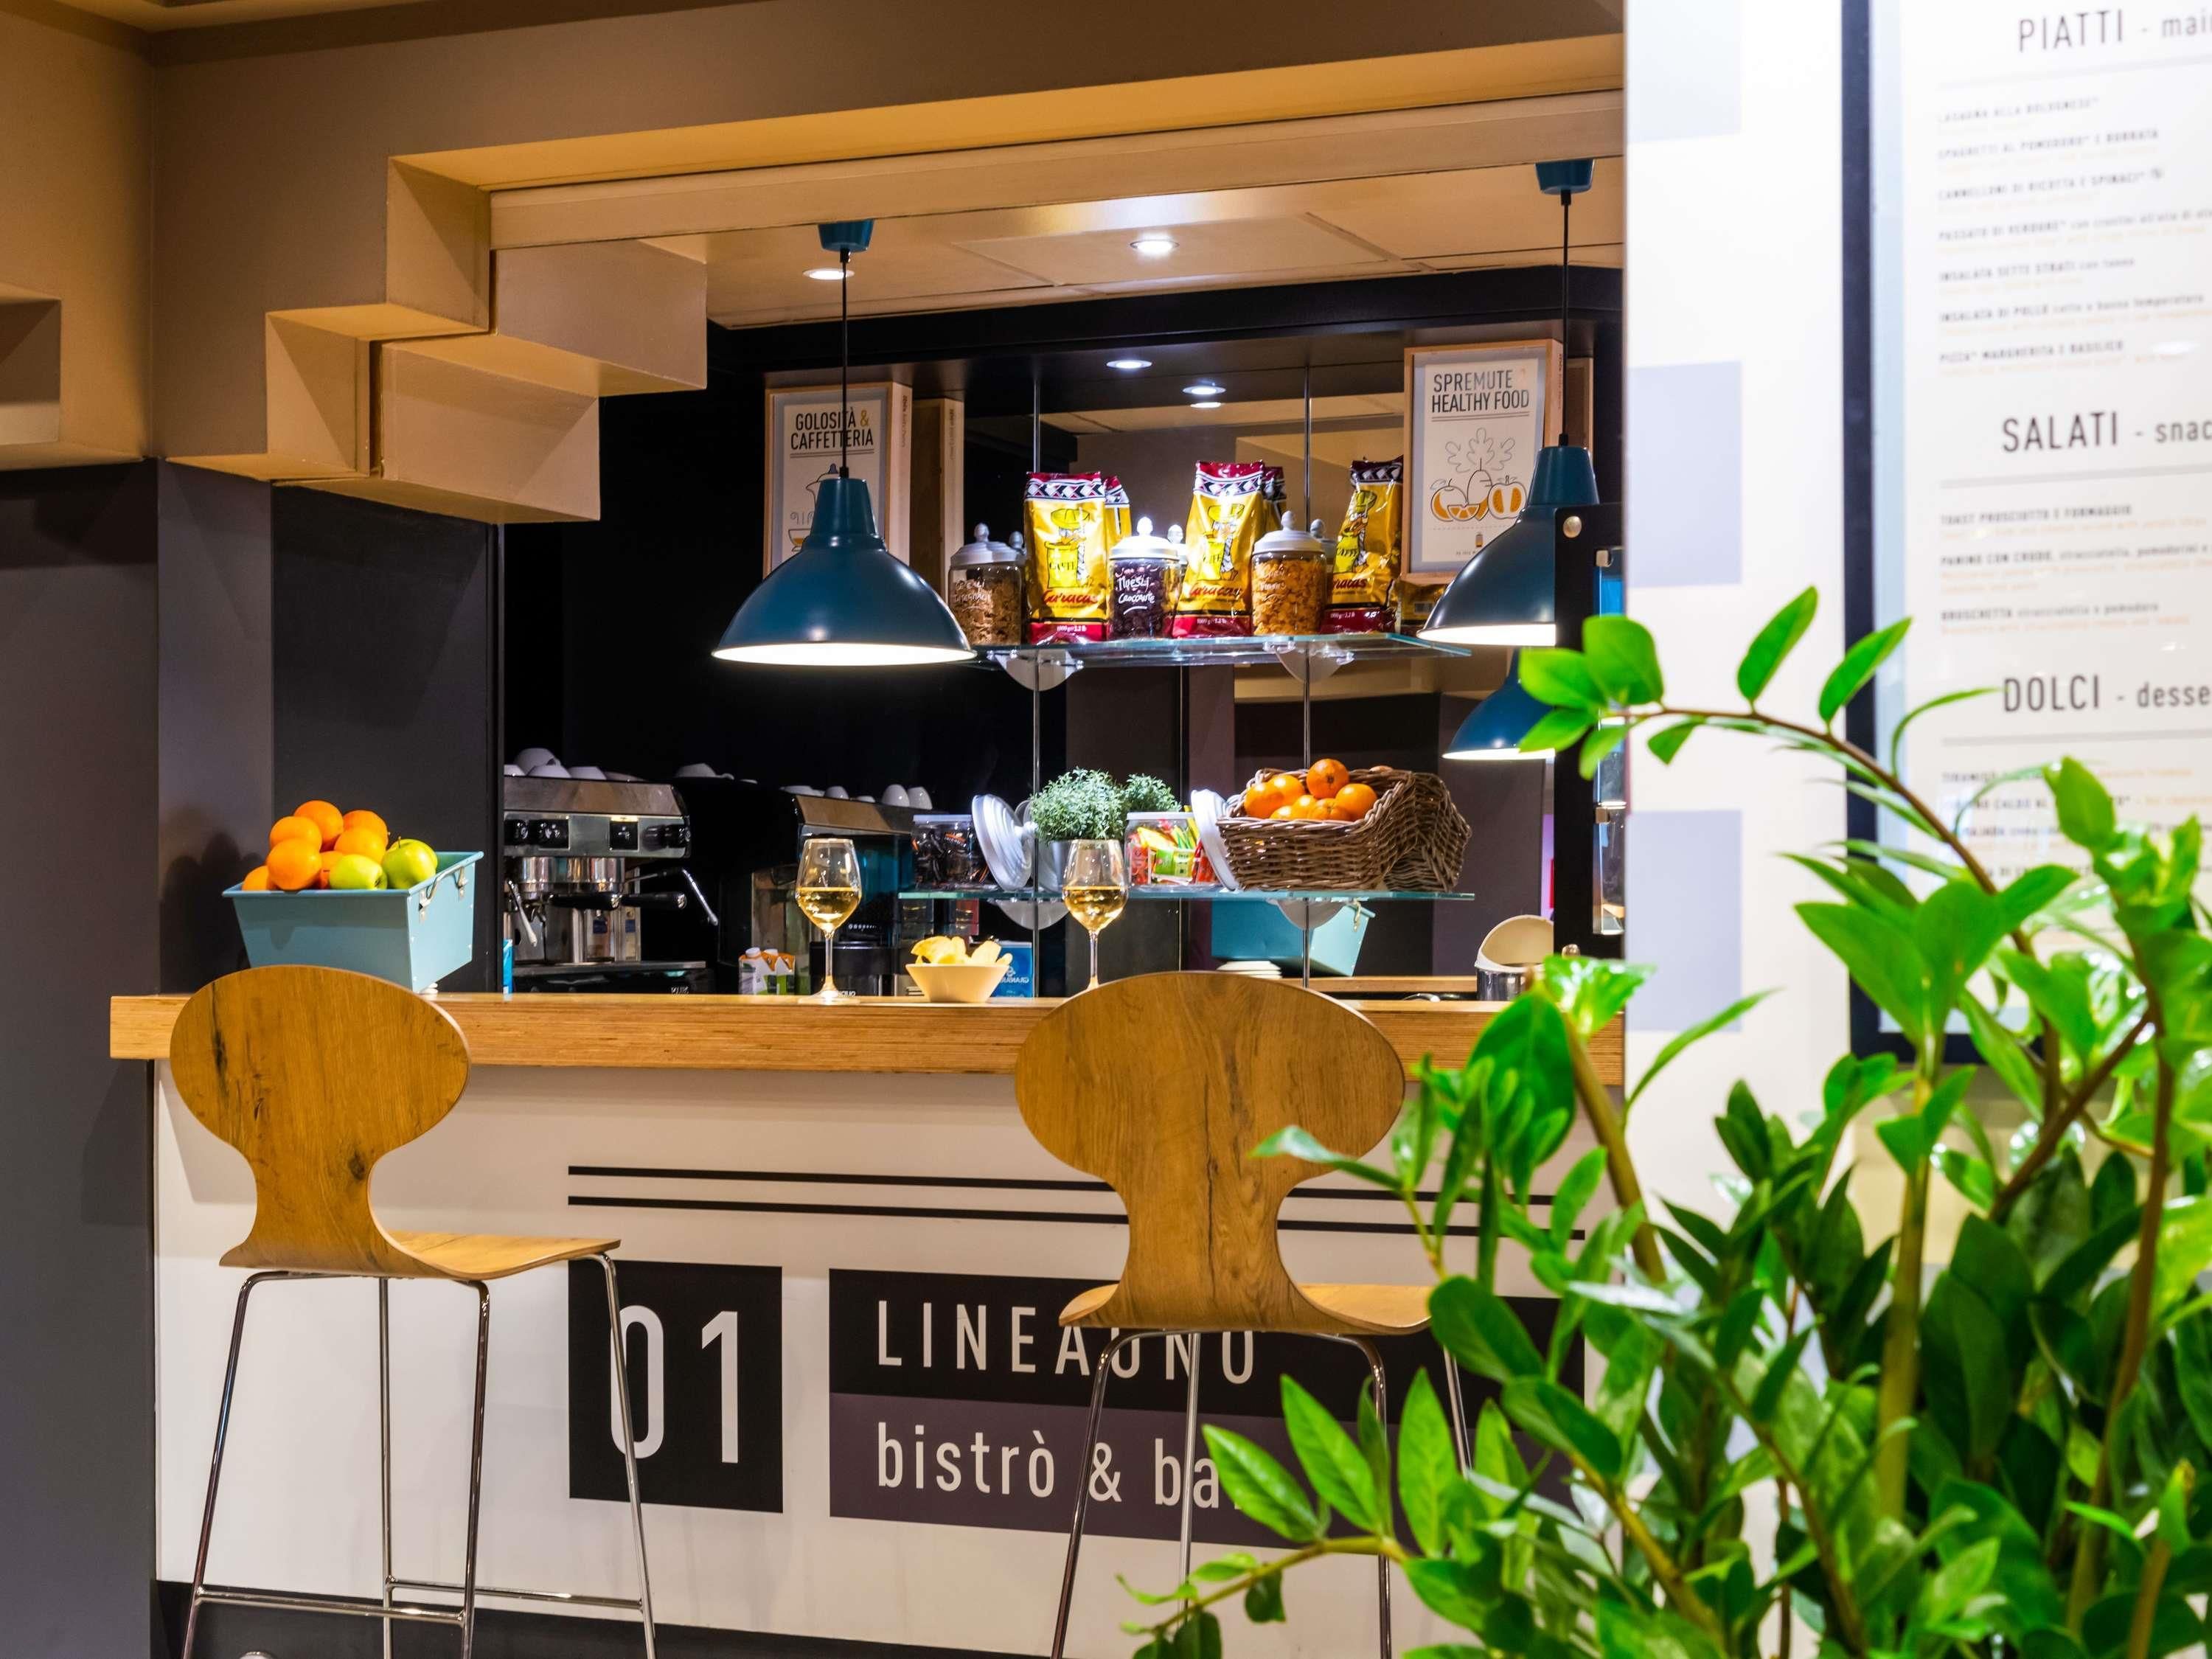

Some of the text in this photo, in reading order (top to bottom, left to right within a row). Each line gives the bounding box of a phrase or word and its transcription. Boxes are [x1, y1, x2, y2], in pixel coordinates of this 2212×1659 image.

[2018, 8, 2123, 52] PIATTI
[2161, 7, 2212, 38] mai
[1432, 390, 1529, 413] HEALTHY FOOD
[1433, 370, 1513, 392] SPREMUTE
[2002, 411, 2118, 453] SALATI
[2003, 675, 2100, 712] DOLCI
[2136, 682, 2211, 709] desse
[878, 1300, 1254, 1385] LINEAUNO
[611, 1305, 739, 1463] 01
[878, 1422, 1241, 1509] bistrò & ba
